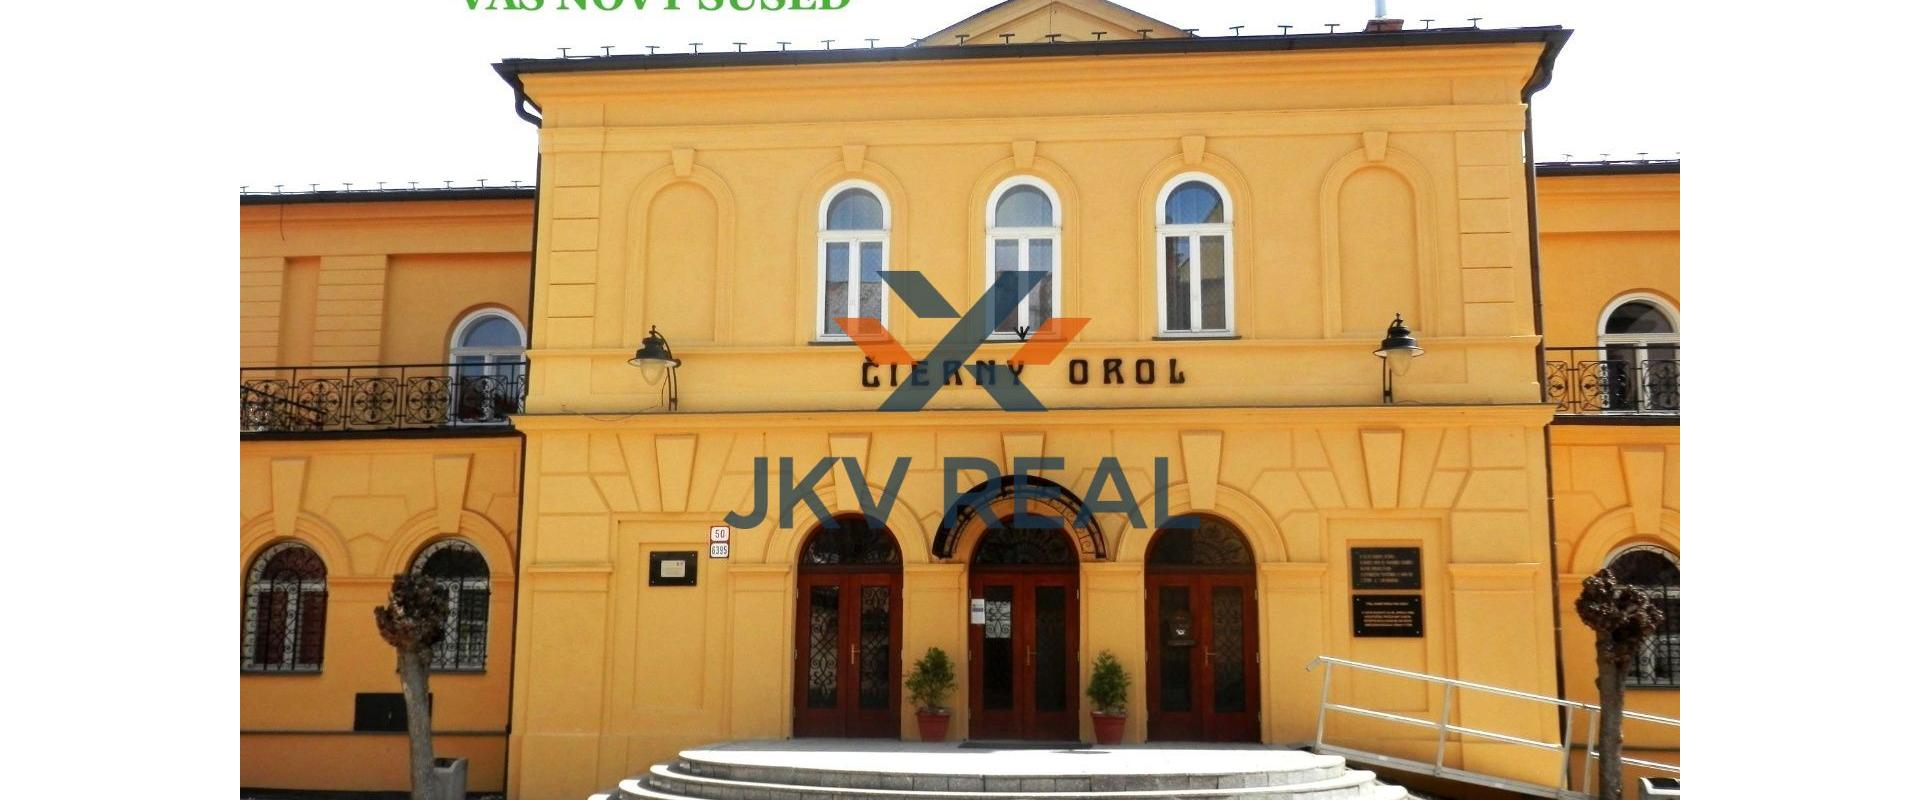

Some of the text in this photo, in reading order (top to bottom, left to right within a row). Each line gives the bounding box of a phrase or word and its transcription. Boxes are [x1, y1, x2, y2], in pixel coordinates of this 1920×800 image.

[861, 355, 1186, 388] ČIERNY OROL
[714, 529, 726, 539] 50
[711, 545, 728, 555] 6395
